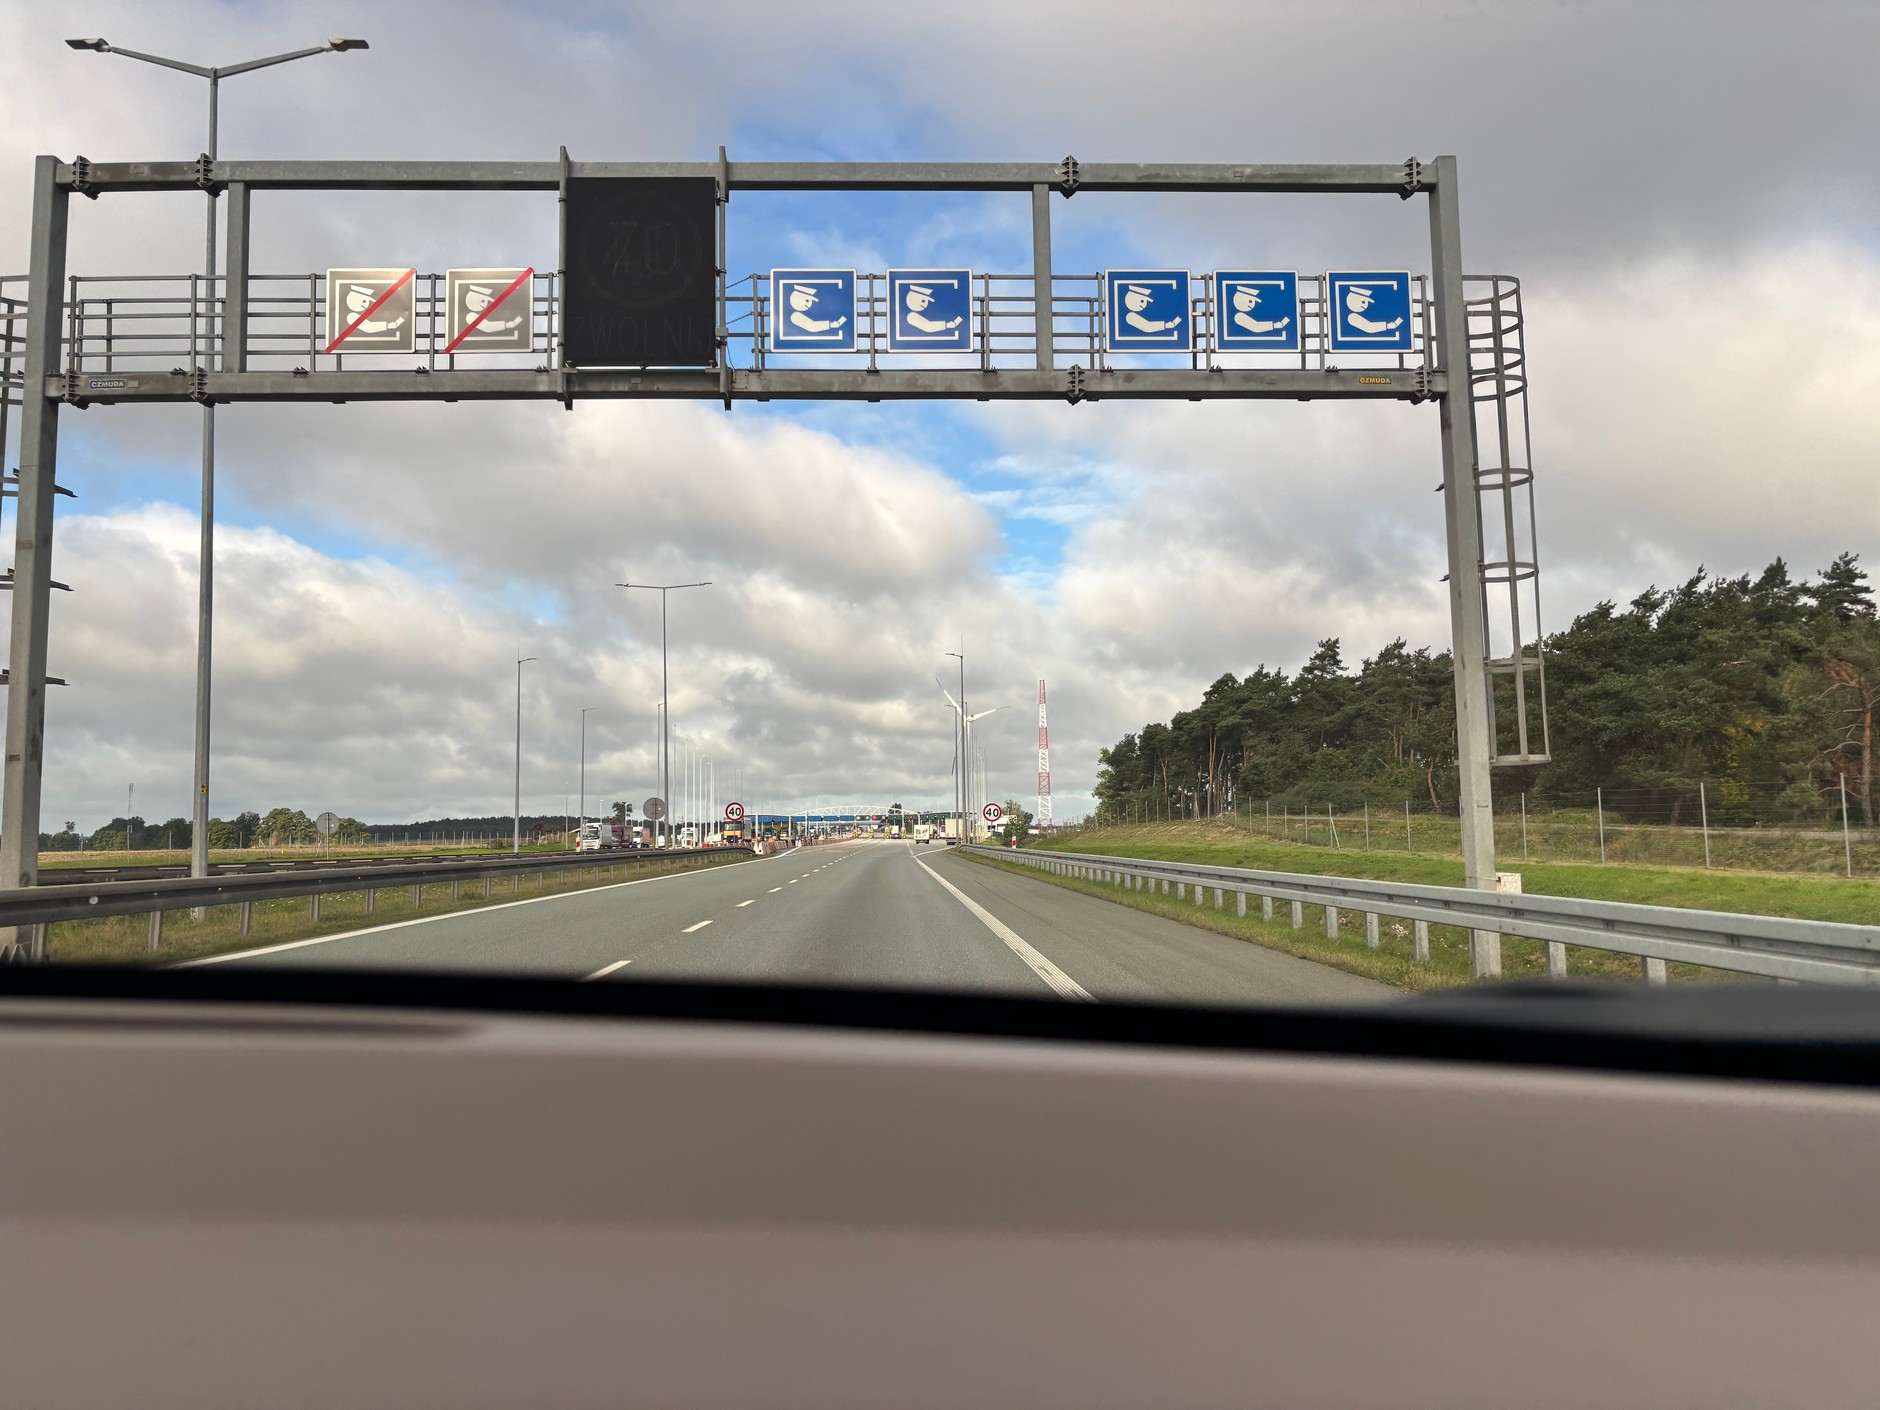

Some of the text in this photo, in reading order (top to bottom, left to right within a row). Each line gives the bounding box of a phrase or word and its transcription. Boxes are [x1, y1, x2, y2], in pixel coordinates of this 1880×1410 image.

[91, 380, 124, 388] CZMUDA
[728, 807, 742, 816] 40
[985, 808, 999, 817] 40
